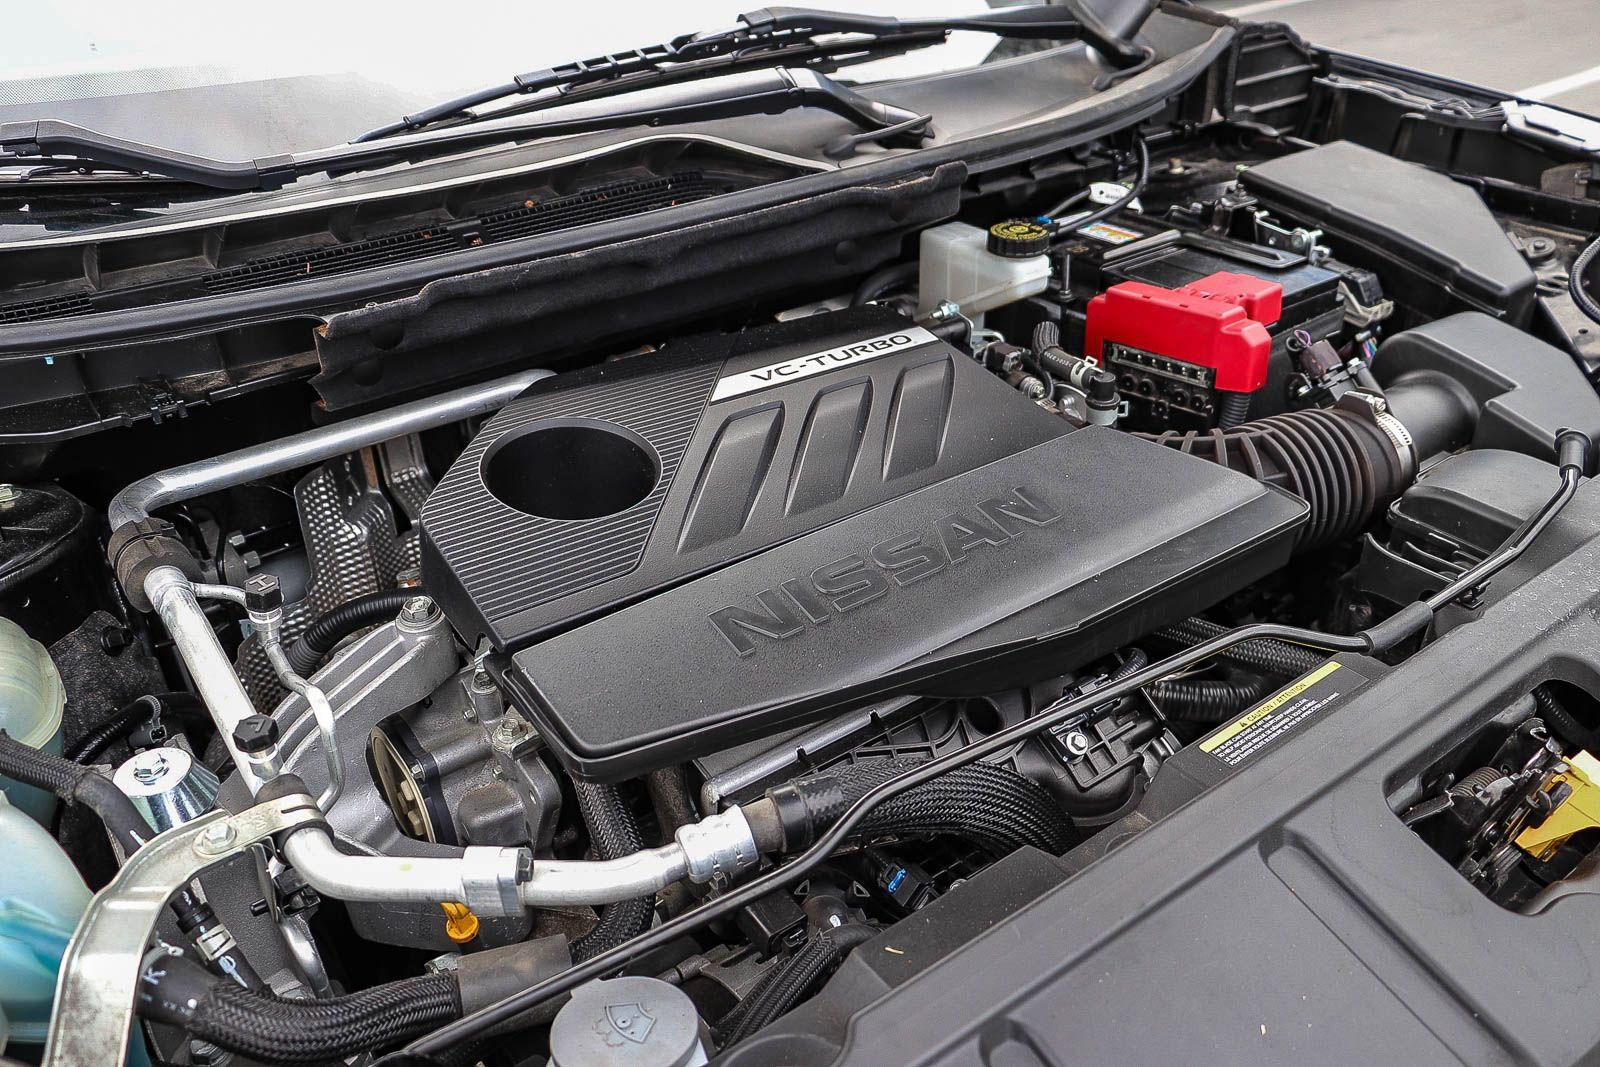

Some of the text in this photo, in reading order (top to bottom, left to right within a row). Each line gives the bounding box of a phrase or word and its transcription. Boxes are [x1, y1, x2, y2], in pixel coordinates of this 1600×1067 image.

[751, 334, 912, 382] VC-TURBO
[706, 485, 1063, 658] NISSAN
[1247, 705, 1273, 722] CAUTION
[1276, 684, 1306, 703] ATTENTION
